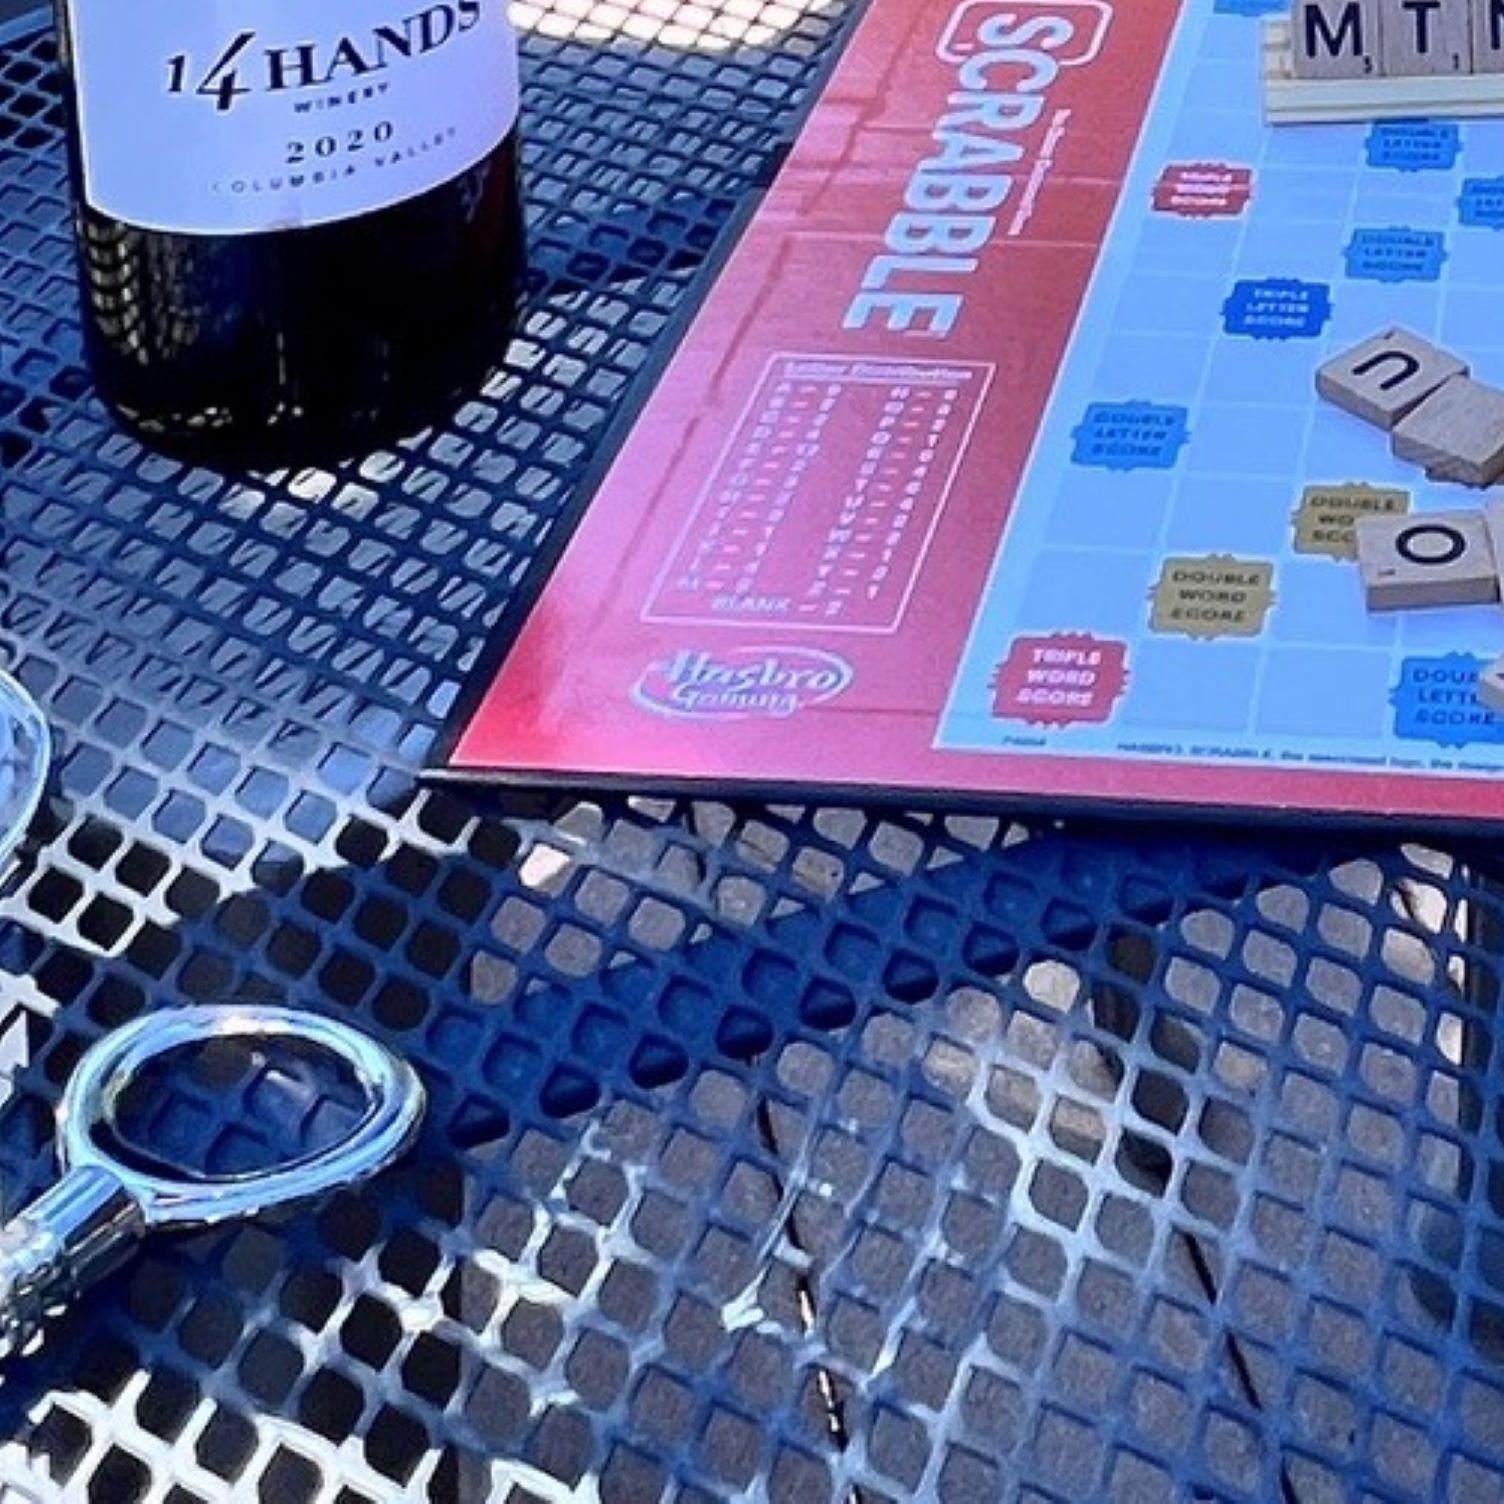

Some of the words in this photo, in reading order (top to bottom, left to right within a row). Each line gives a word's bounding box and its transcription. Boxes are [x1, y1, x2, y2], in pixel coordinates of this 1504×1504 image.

[166, 32, 256, 111] 14
[294, 82, 388, 113] WINERY
[285, 121, 394, 164] 2020
[843, 13, 1075, 339] SCRABBLE
[1351, 350, 1421, 391] U
[1317, 513, 1355, 525] WO
[1395, 523, 1467, 565] O
[1031, 647, 1102, 666] TRIPLE
[668, 649, 841, 694] Hasbro
[1026, 667, 1096, 687] WORD
[1412, 668, 1478, 684] DOUB
[1015, 689, 1094, 708] SCORE
[1418, 689, 1480, 704] LETT
[1414, 709, 1496, 726] SCORE
